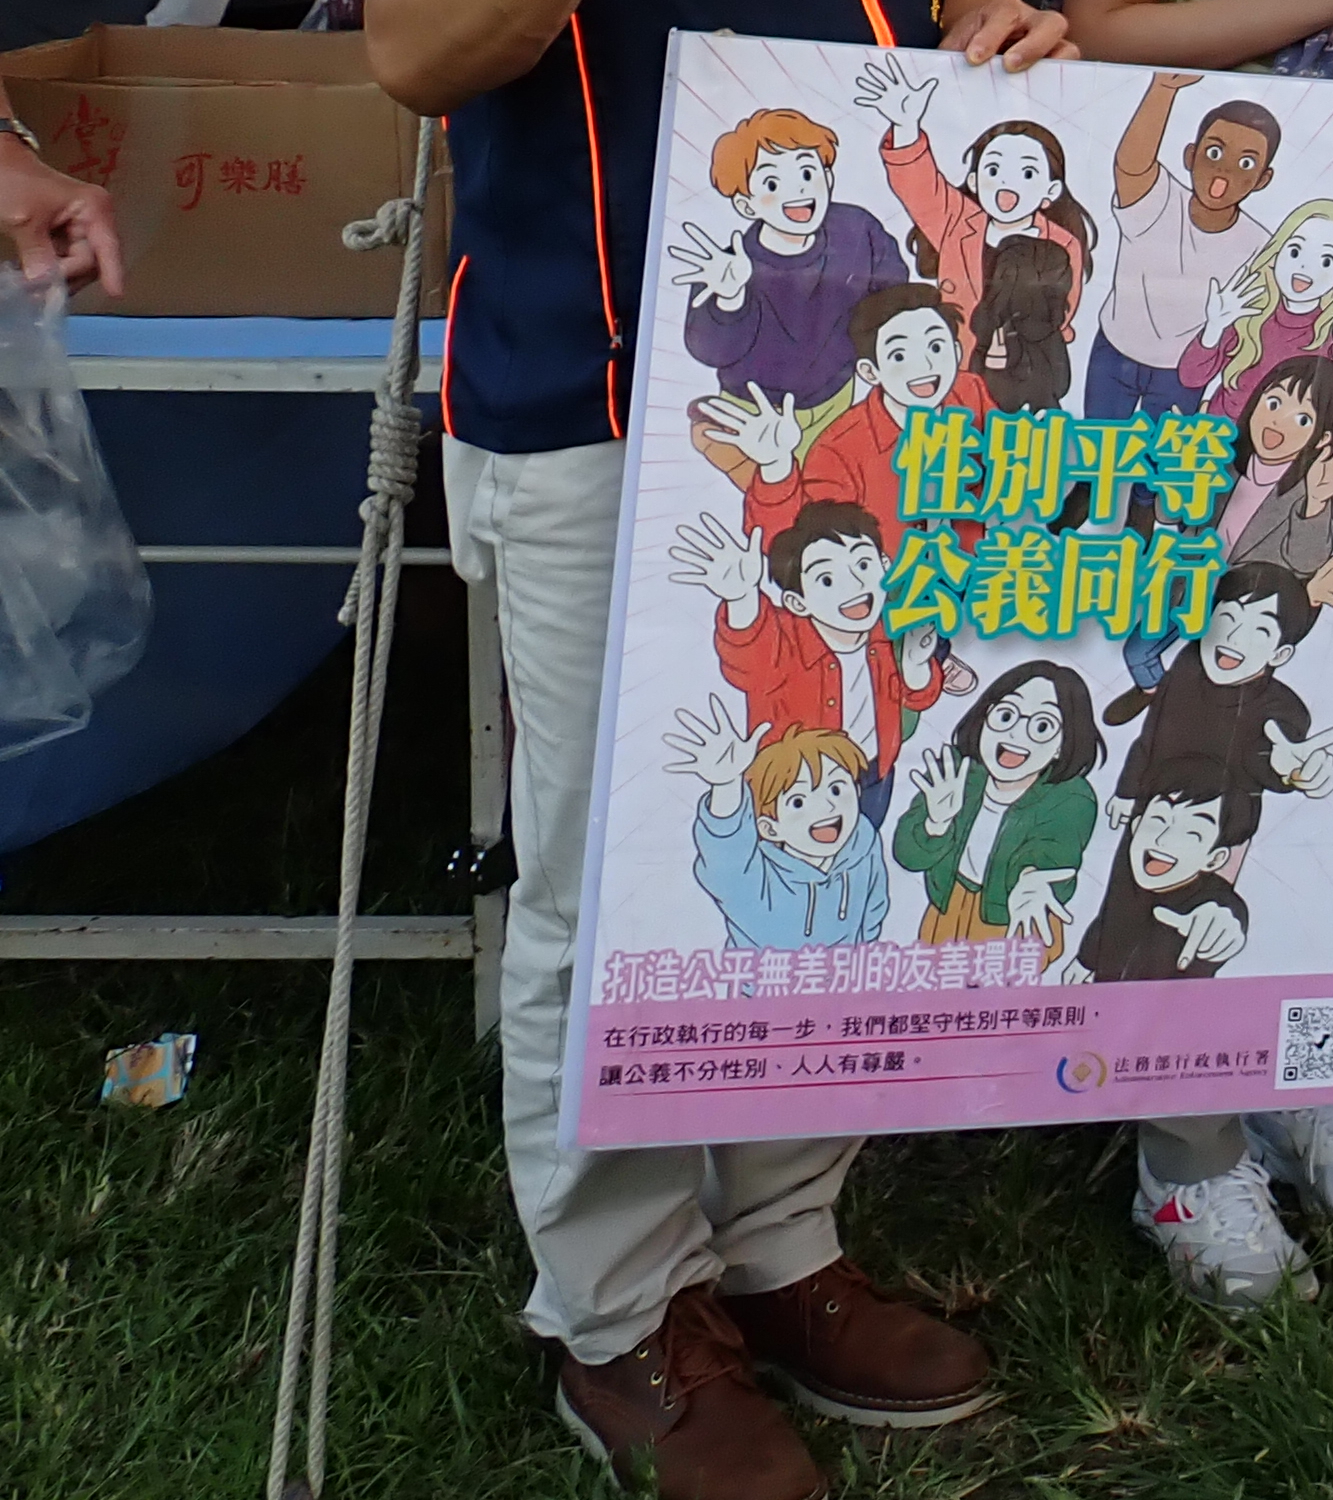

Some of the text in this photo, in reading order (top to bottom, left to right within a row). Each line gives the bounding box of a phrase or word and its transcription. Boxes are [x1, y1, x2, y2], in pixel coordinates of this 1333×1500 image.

[899, 408, 1240, 526] 性別平等
[886, 530, 1229, 638] 公義同行
[604, 937, 1045, 1005] 打造公平無差別的友善環境
[1113, 1050, 1270, 1073] 法務部行政執行署
